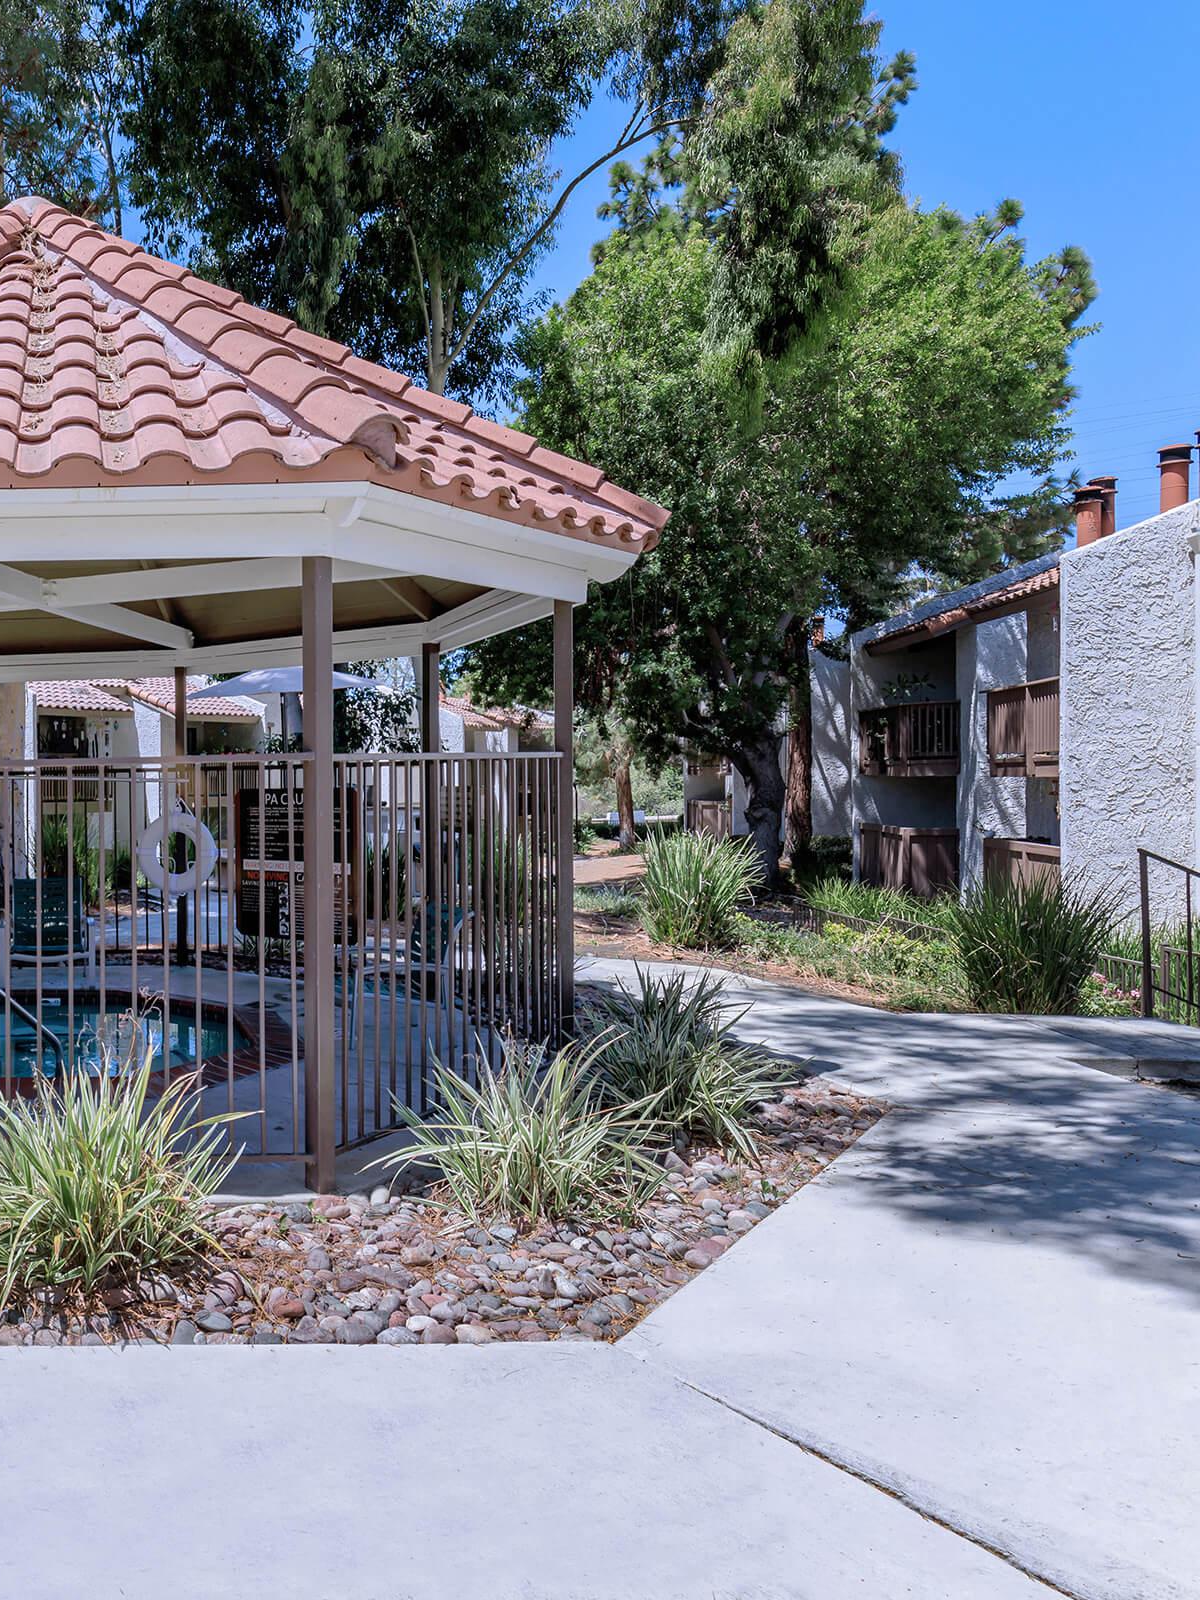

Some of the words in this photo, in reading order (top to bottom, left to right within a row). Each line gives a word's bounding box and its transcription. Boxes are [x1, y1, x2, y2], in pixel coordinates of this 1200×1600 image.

[264, 793, 278, 805] PA
[247, 871, 259, 880] NO
[267, 872, 288, 881] IVING
